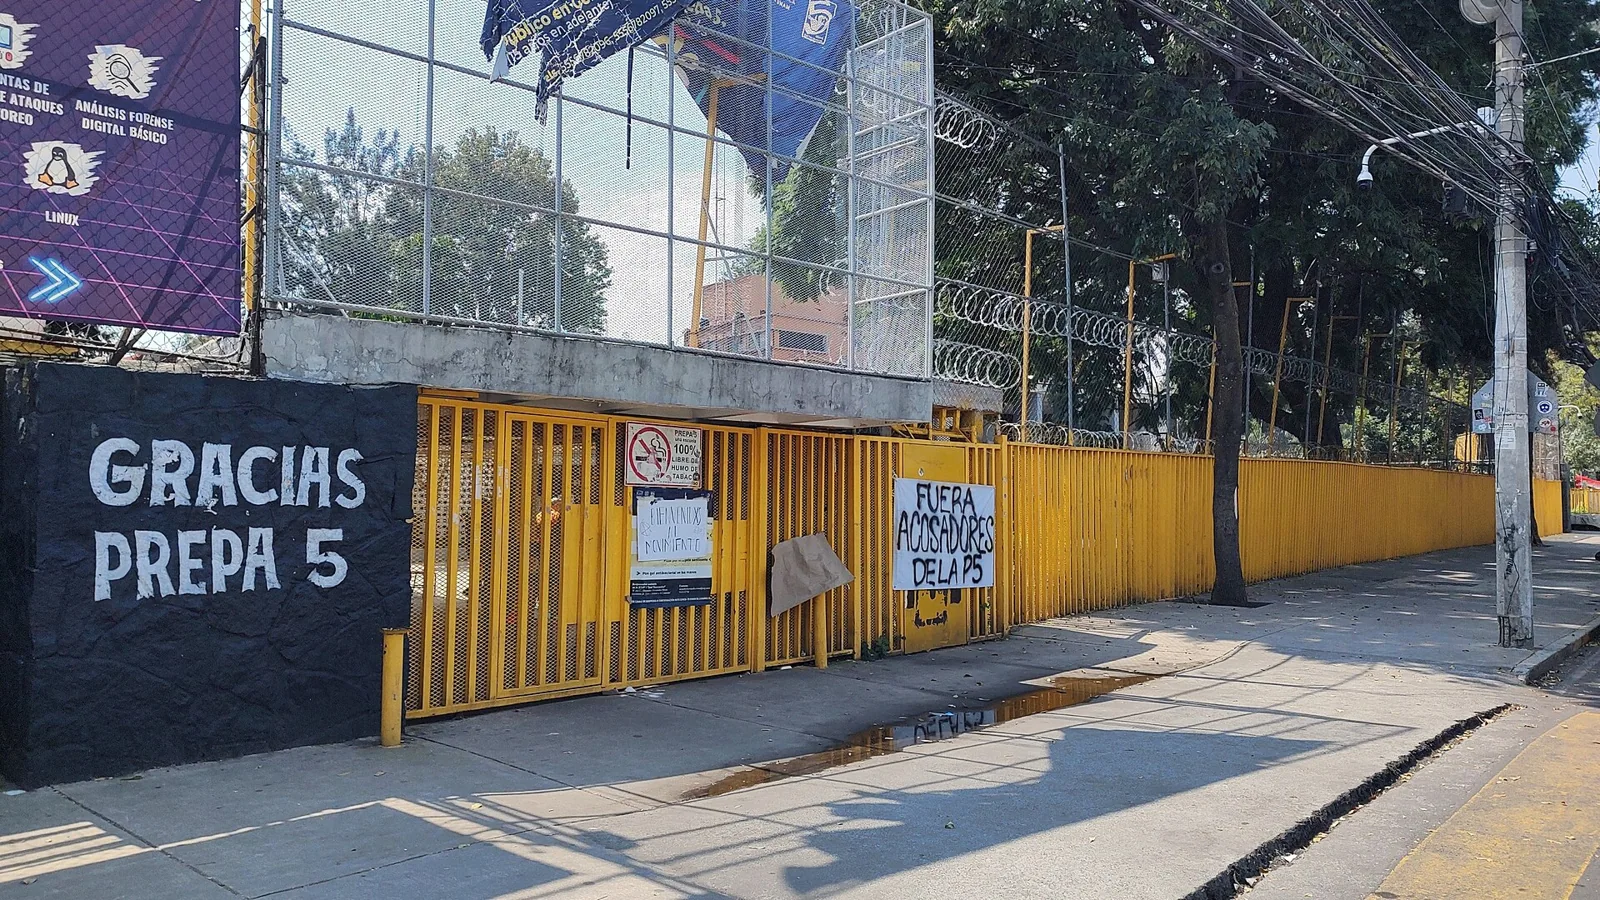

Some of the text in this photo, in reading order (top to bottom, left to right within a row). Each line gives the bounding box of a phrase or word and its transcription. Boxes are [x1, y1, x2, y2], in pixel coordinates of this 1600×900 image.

[552, 4, 571, 20] en
[550, 25, 567, 39] en
[33, 81, 50, 95] DE
[9, 93, 64, 115] ATAQUES
[75, 100, 174, 131] ANÁLISIS FORENSE
[82, 117, 168, 145] DIGITAL BÁSICO
[45, 210, 80, 226] LINUX
[89, 437, 366, 509] GRACIAS
[916, 483, 977, 517] FUERA
[897, 511, 994, 554] ACOSADORES
[94, 526, 349, 601] PREPA 5
[963, 554, 983, 584] P5
